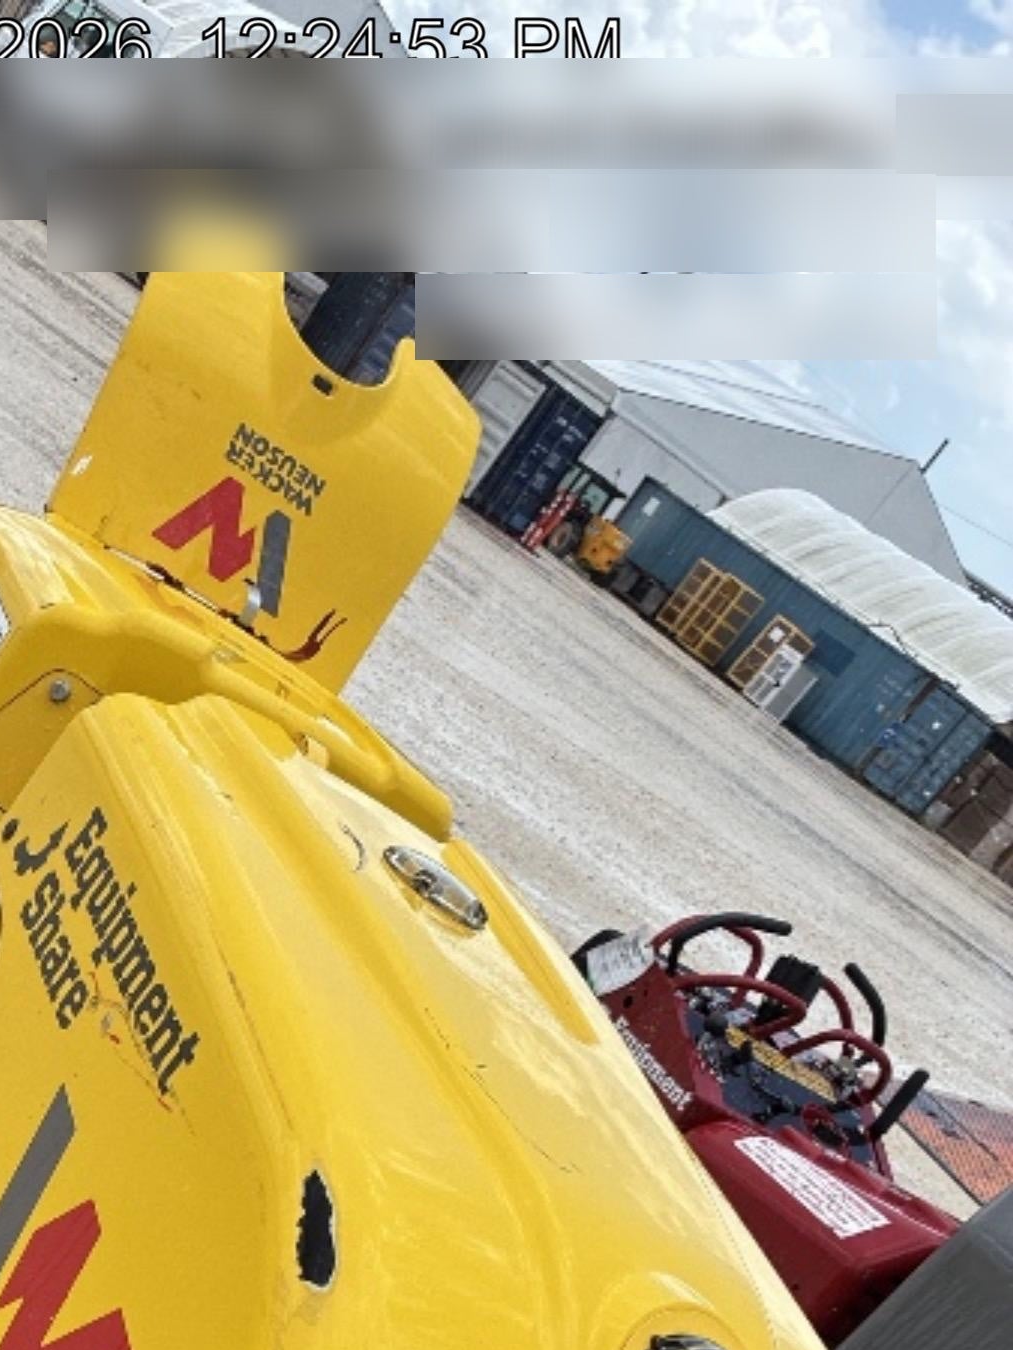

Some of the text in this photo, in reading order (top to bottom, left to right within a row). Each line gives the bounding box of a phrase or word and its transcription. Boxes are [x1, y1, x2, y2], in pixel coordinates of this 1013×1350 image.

[225, 440, 313, 516] WACKER
[234, 423, 326, 497] NEUSON
[20, 871, 89, 1030] Share
[65, 806, 200, 1094] Equipment
